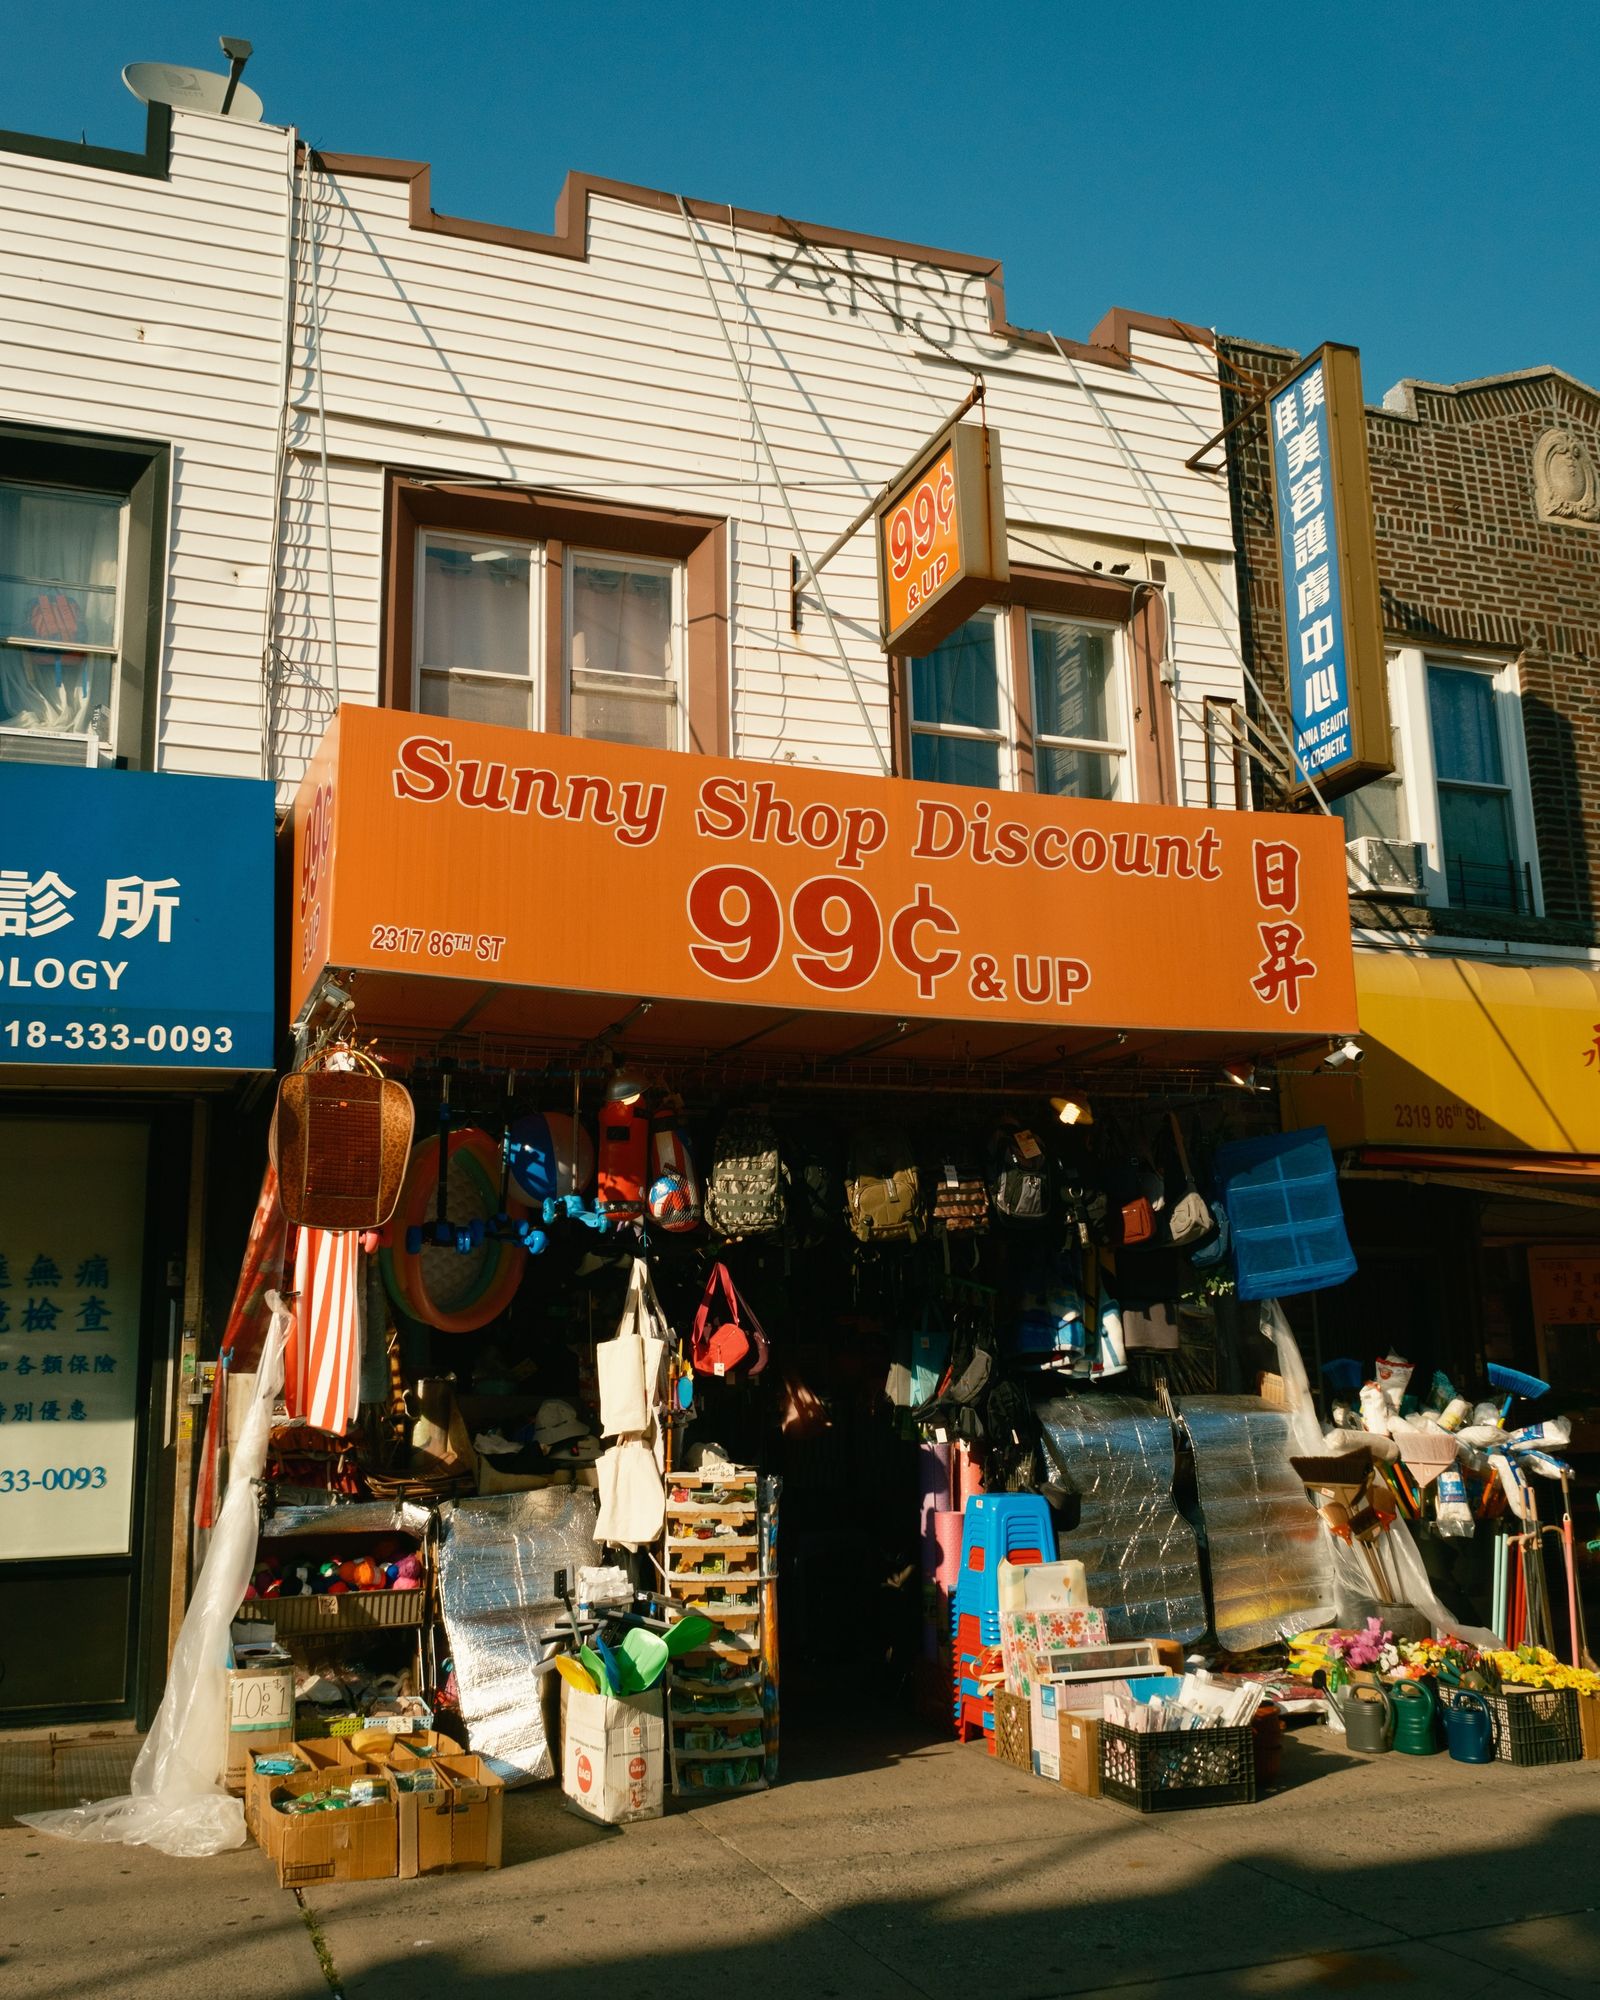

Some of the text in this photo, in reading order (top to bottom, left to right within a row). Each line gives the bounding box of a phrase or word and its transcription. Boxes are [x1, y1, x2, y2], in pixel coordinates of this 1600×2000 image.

[890, 462, 955, 581] 99¢
[907, 552, 949, 613] & UP
[1298, 707, 1349, 752] ANNA BEAUTY
[1311, 733, 1347, 768] COSMETIC
[393, 735, 1222, 881] Sunny Shop Discount
[0, 870, 181, 943] 診所
[370, 925, 506, 962] 2317 86TH ST
[687, 864, 1091, 1006] 99¢ & UP
[0, 957, 129, 990] LOGY
[5, 1020, 233, 1053] 18-333-0093
[1395, 1102, 1487, 1132] 2319 86th St.
[0, 1295, 112, 1333] 檢查
[0, 1398, 88, 1422] 別優惠
[233, 1682, 262, 1719] 10
